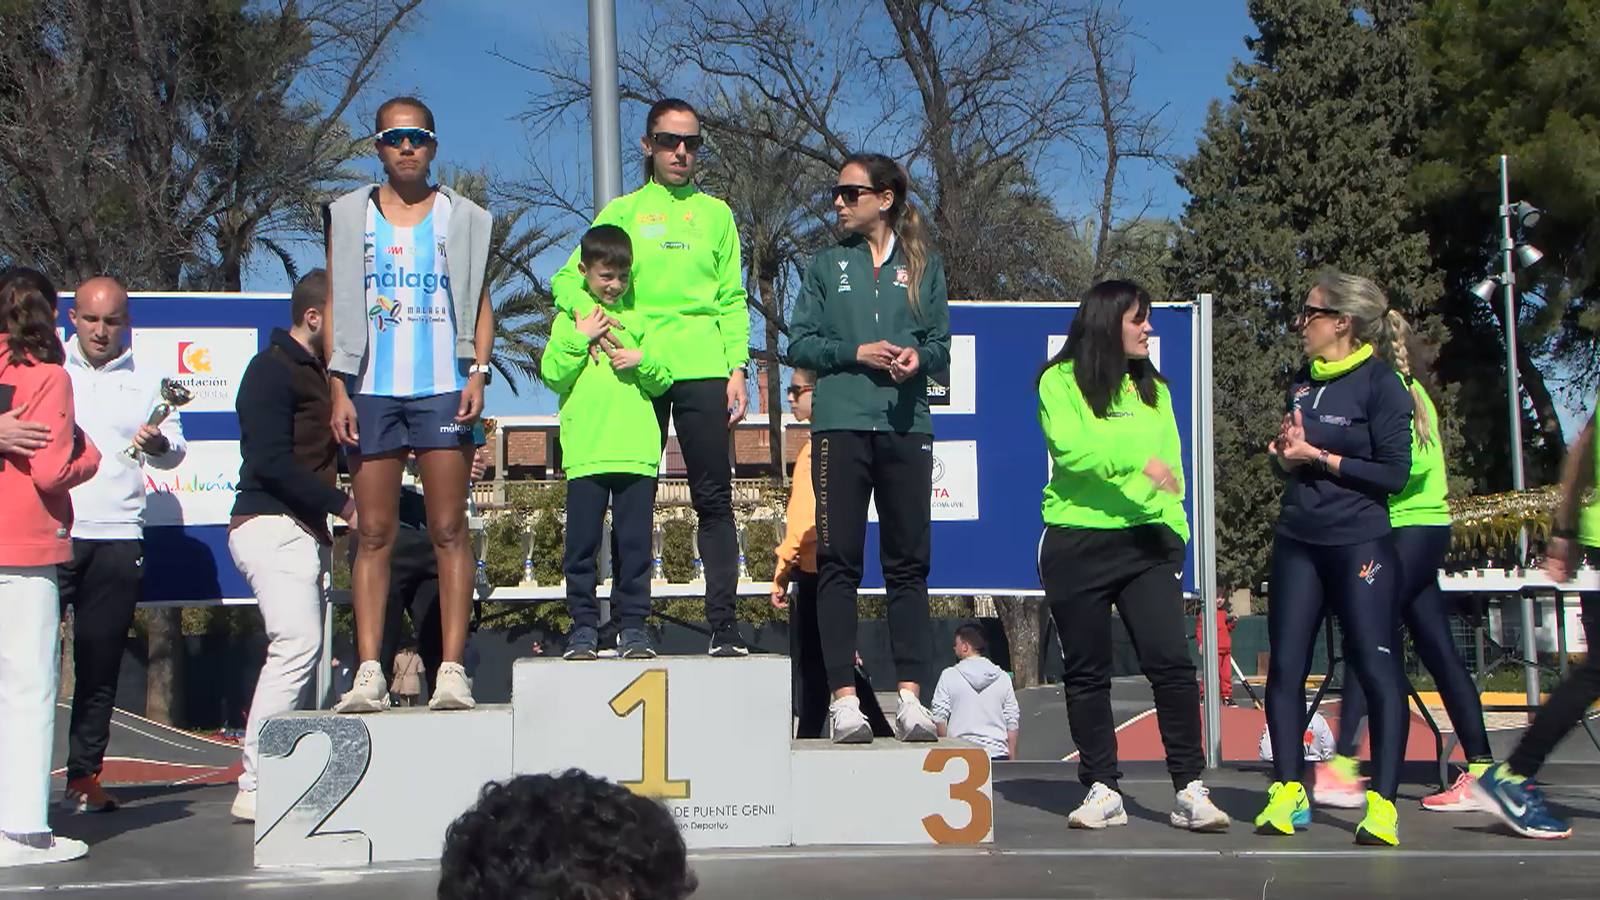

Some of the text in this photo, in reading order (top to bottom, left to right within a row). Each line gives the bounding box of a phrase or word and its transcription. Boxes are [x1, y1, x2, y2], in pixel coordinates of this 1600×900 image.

[820, 438, 829, 488] CIUDAD
[608, 668, 691, 799] 1
[252, 716, 373, 867] 2
[693, 804, 738, 817] PUENTE
[921, 748, 992, 845] 3
